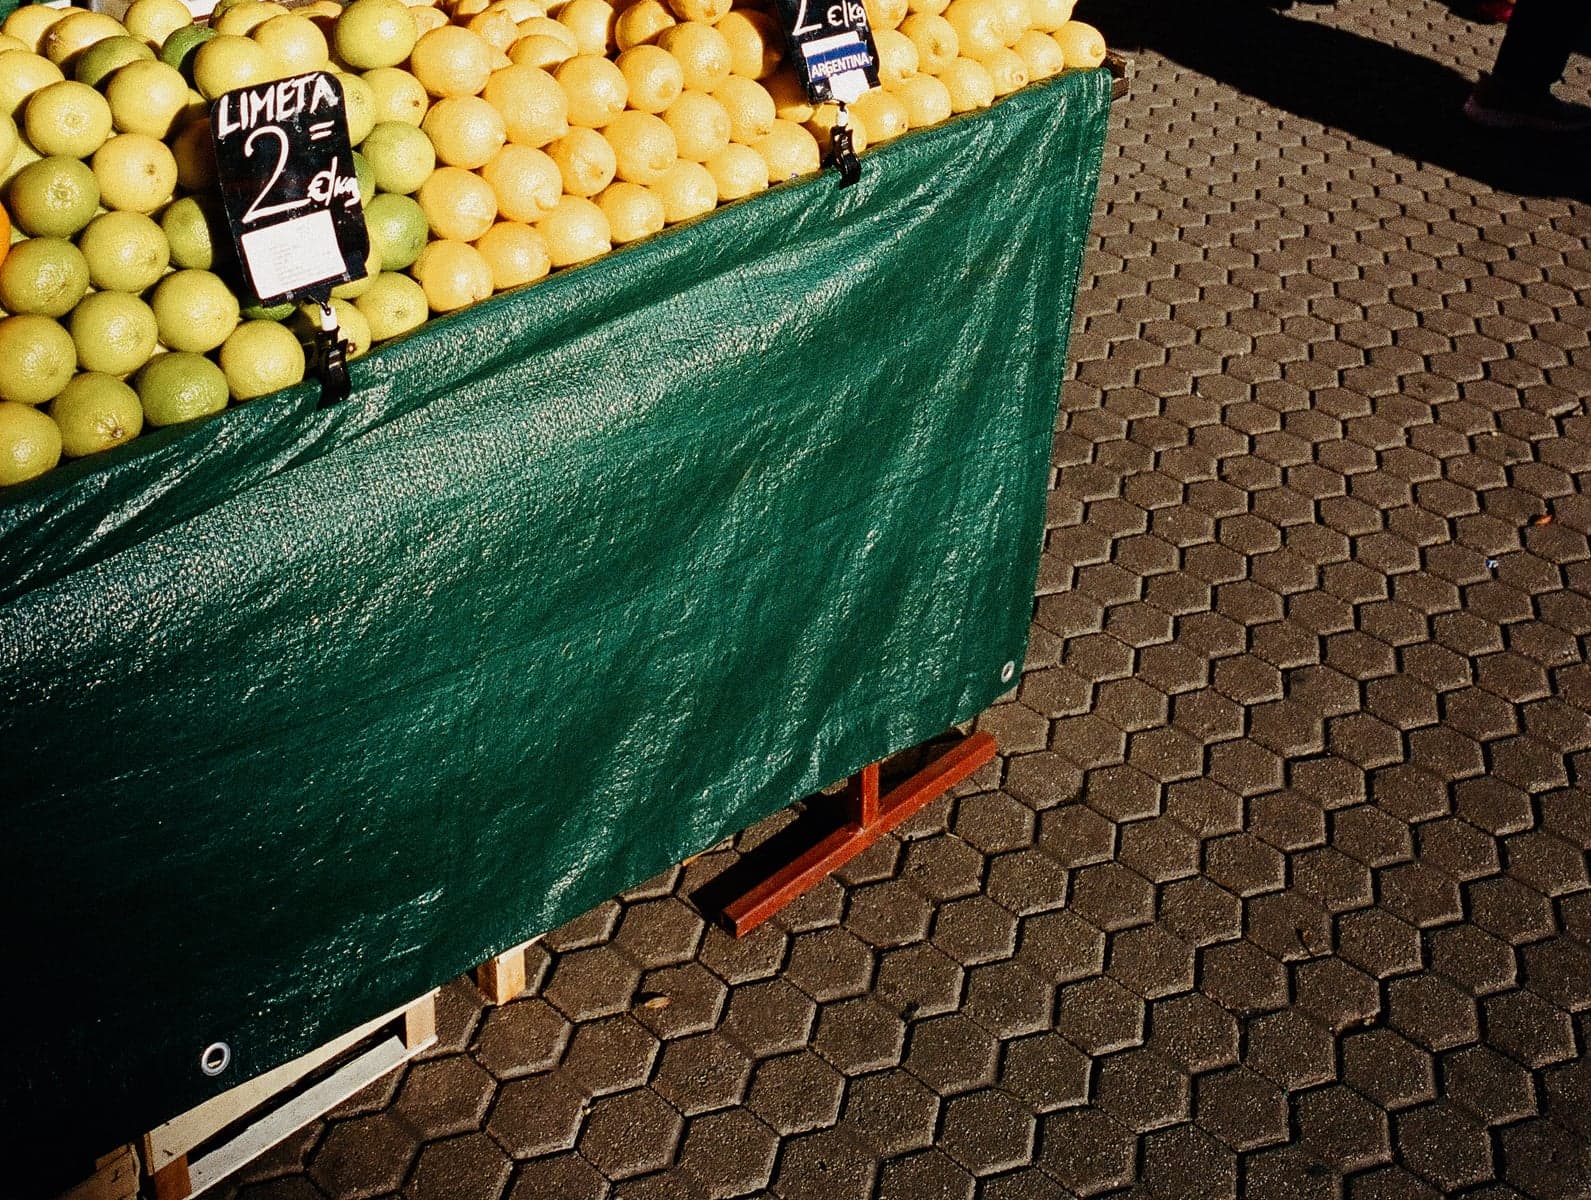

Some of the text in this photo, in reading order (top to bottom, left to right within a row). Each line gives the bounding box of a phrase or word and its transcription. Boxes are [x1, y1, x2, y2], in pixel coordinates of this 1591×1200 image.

[827, 0, 867, 26] €/kg
[811, 52, 870, 78] ARGENTINA
[218, 72, 339, 140] LIMETA
[307, 156, 360, 207] €/kg
